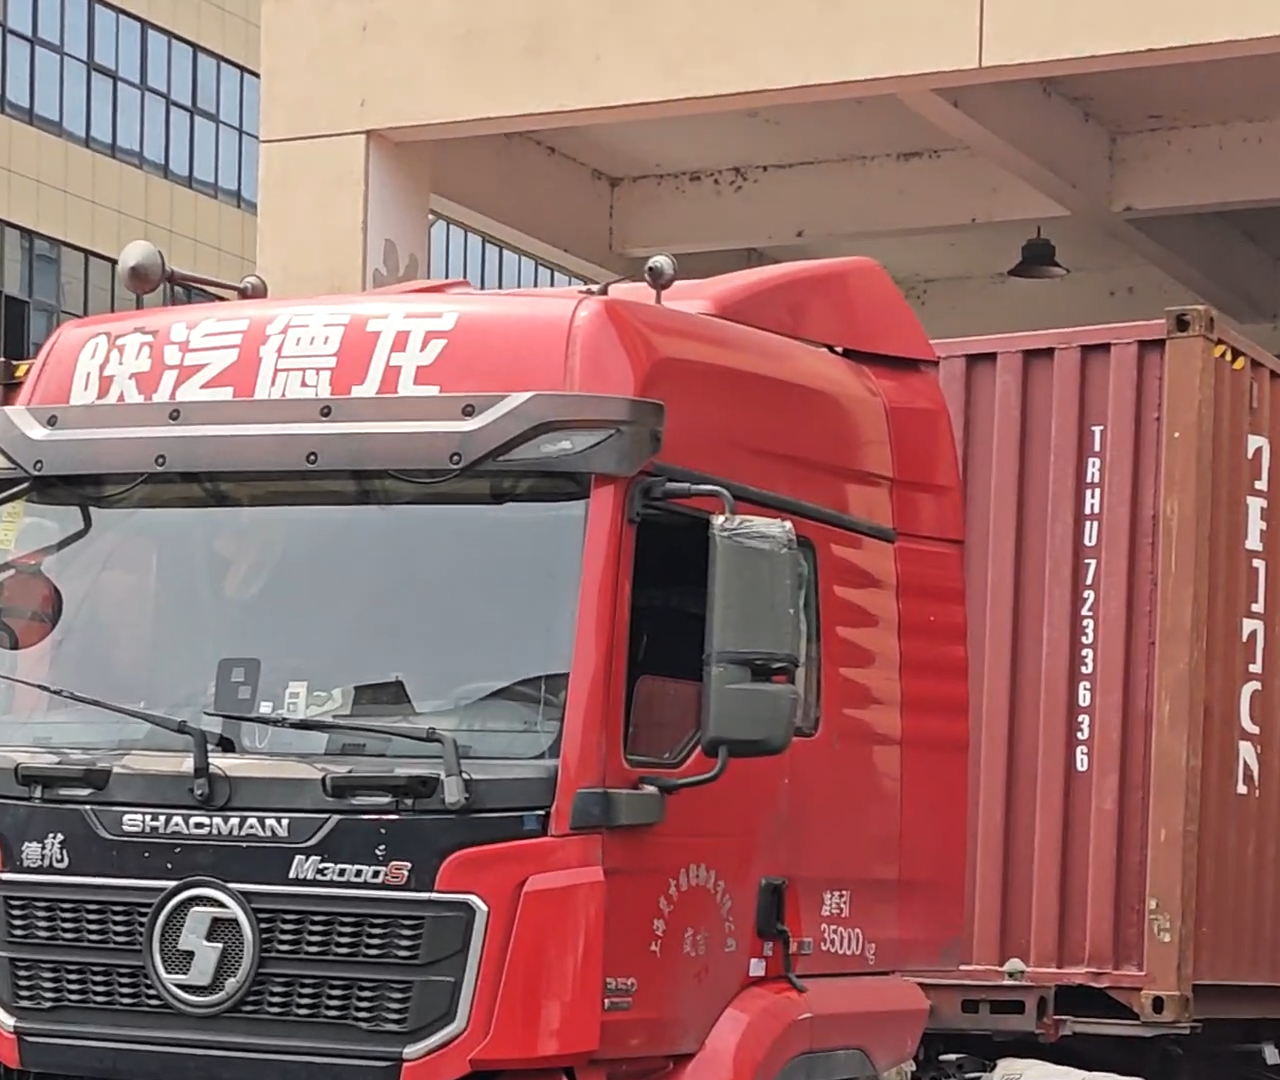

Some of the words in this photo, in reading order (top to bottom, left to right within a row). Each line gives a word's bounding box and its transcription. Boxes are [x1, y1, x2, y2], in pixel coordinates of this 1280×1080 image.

[70, 312, 459, 405] 陕汽德龙
[1083, 425, 1105, 547] TRHU
[121, 814, 290, 838] SHACMAN
[287, 855, 412, 885] M3000S
[820, 922, 864, 956] 35000
